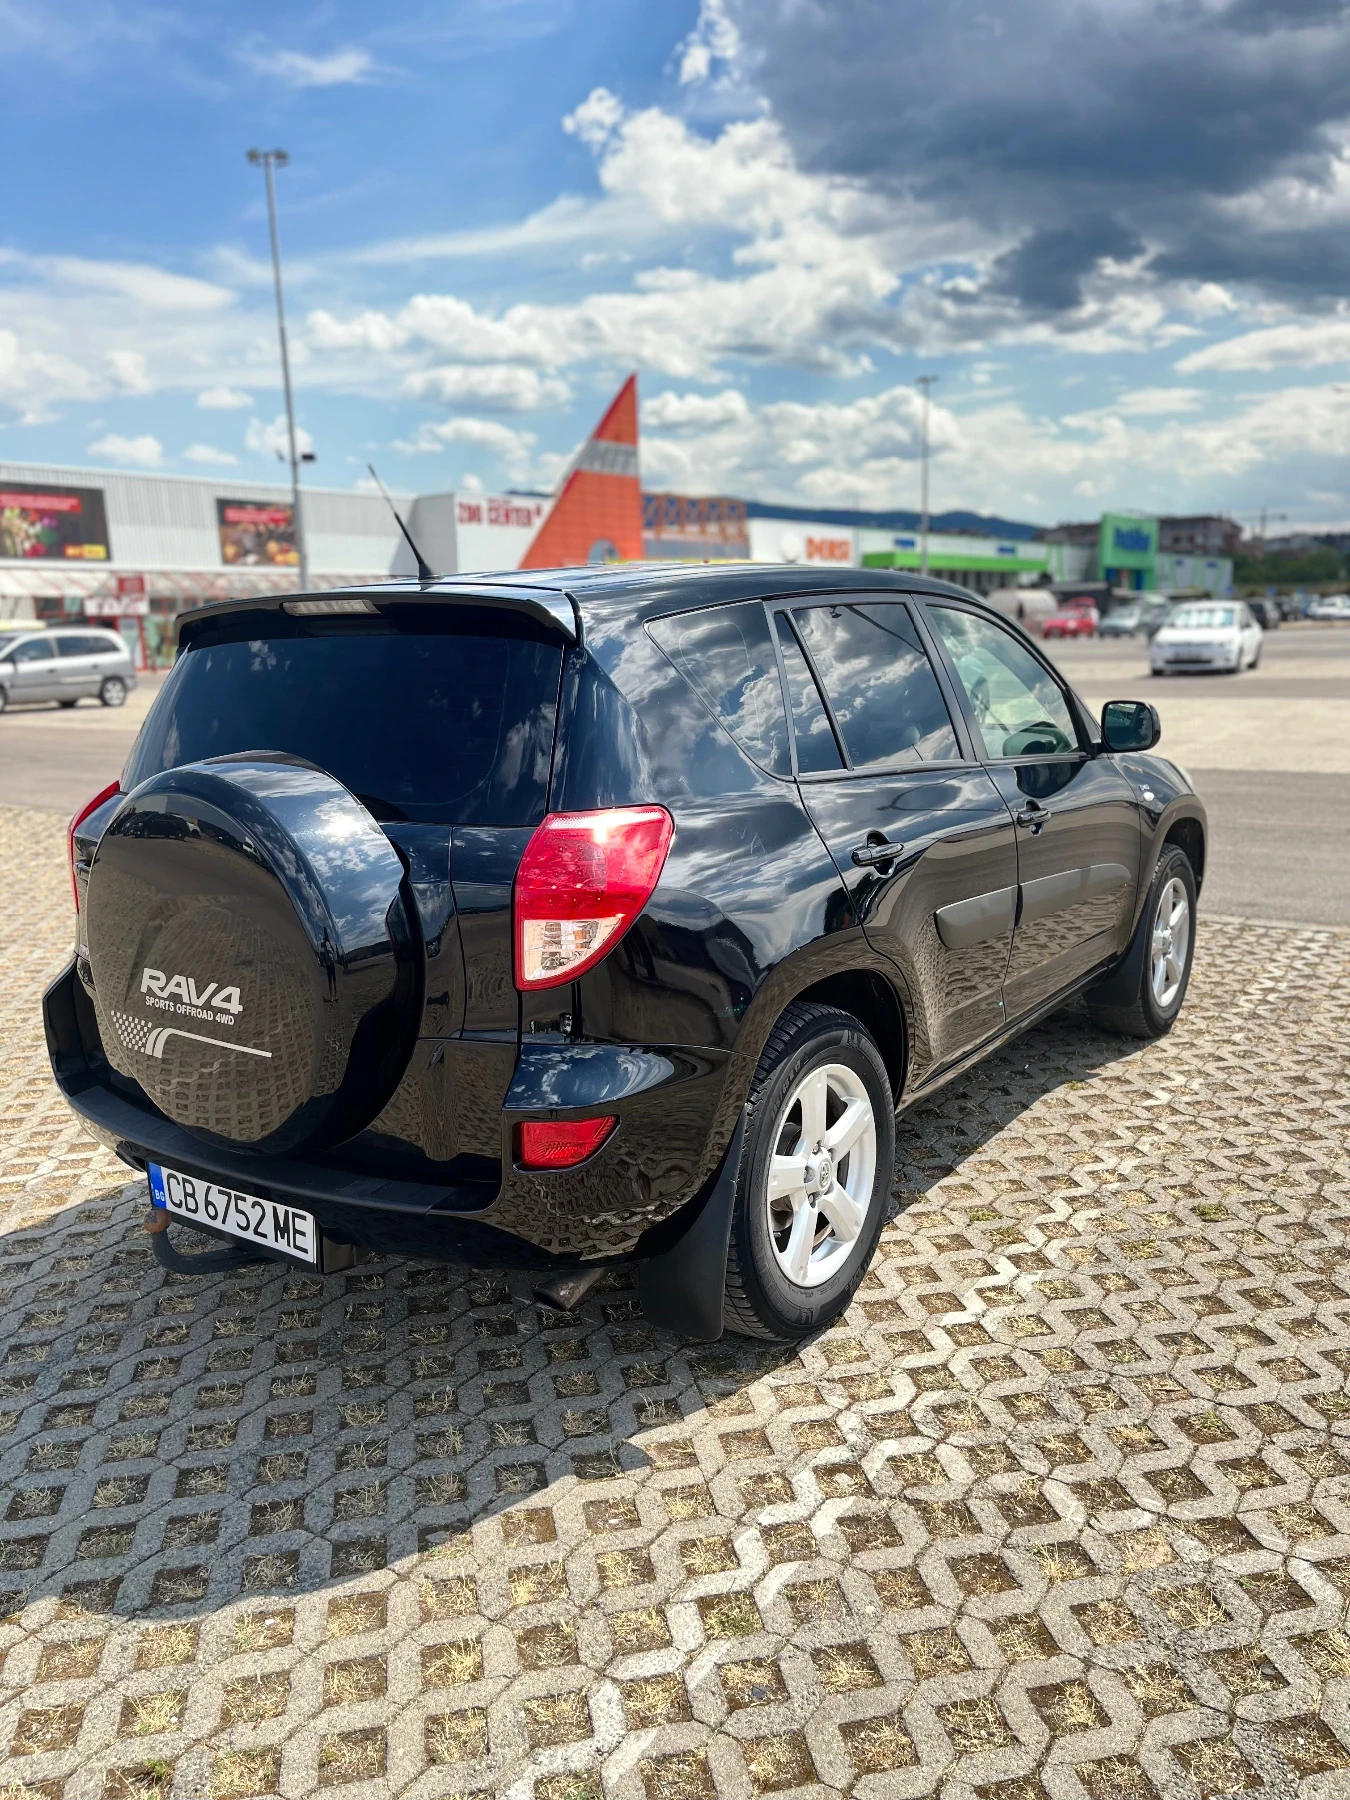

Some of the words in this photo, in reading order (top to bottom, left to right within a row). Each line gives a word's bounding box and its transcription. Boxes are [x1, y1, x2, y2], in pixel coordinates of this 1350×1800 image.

[140, 967, 243, 1015] RAV4
[145, 996, 175, 1012] SPORTS
[176, 1004, 214, 1021] OFFROAD
[215, 1012, 235, 1026] 4WD
[154, 1188, 165, 1202] BG
